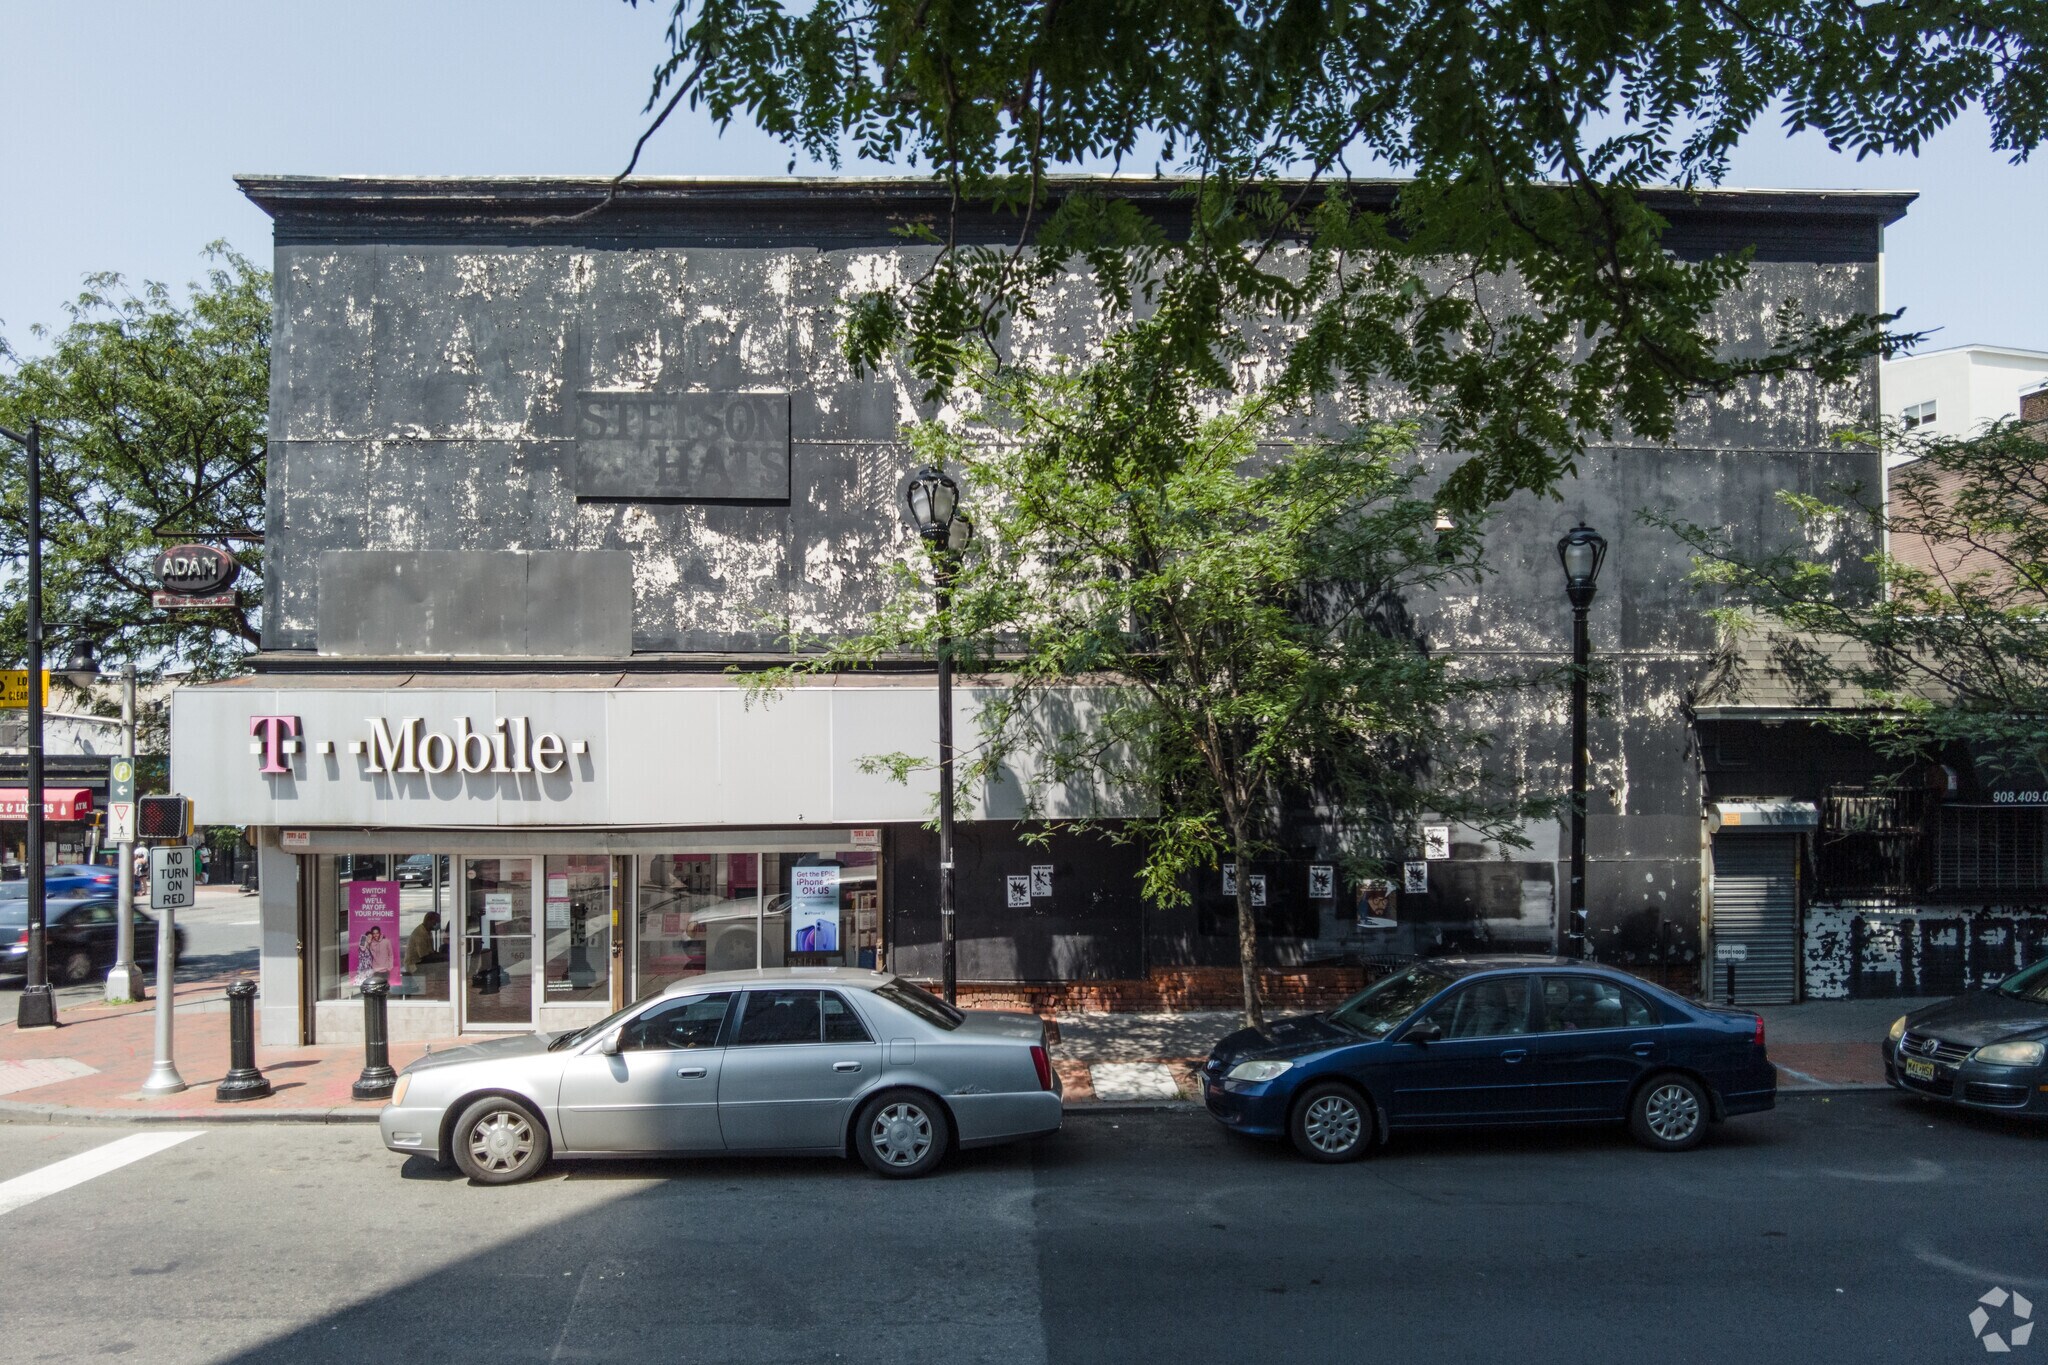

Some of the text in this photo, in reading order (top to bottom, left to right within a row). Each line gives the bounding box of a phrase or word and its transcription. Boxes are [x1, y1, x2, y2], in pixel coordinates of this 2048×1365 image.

[577, 401, 787, 442] STETSON
[654, 445, 787, 488] HATS
[161, 556, 218, 577] ADAM
[16, 803, 54, 813] LIQRS
[75, 801, 88, 811] ATM
[167, 852, 182, 865] NO
[160, 868, 189, 880] TURN
[167, 881, 182, 892] ON
[796, 878, 824, 886] iPhone
[802, 886, 830, 895] ON US
[163, 893, 185, 905] RED
